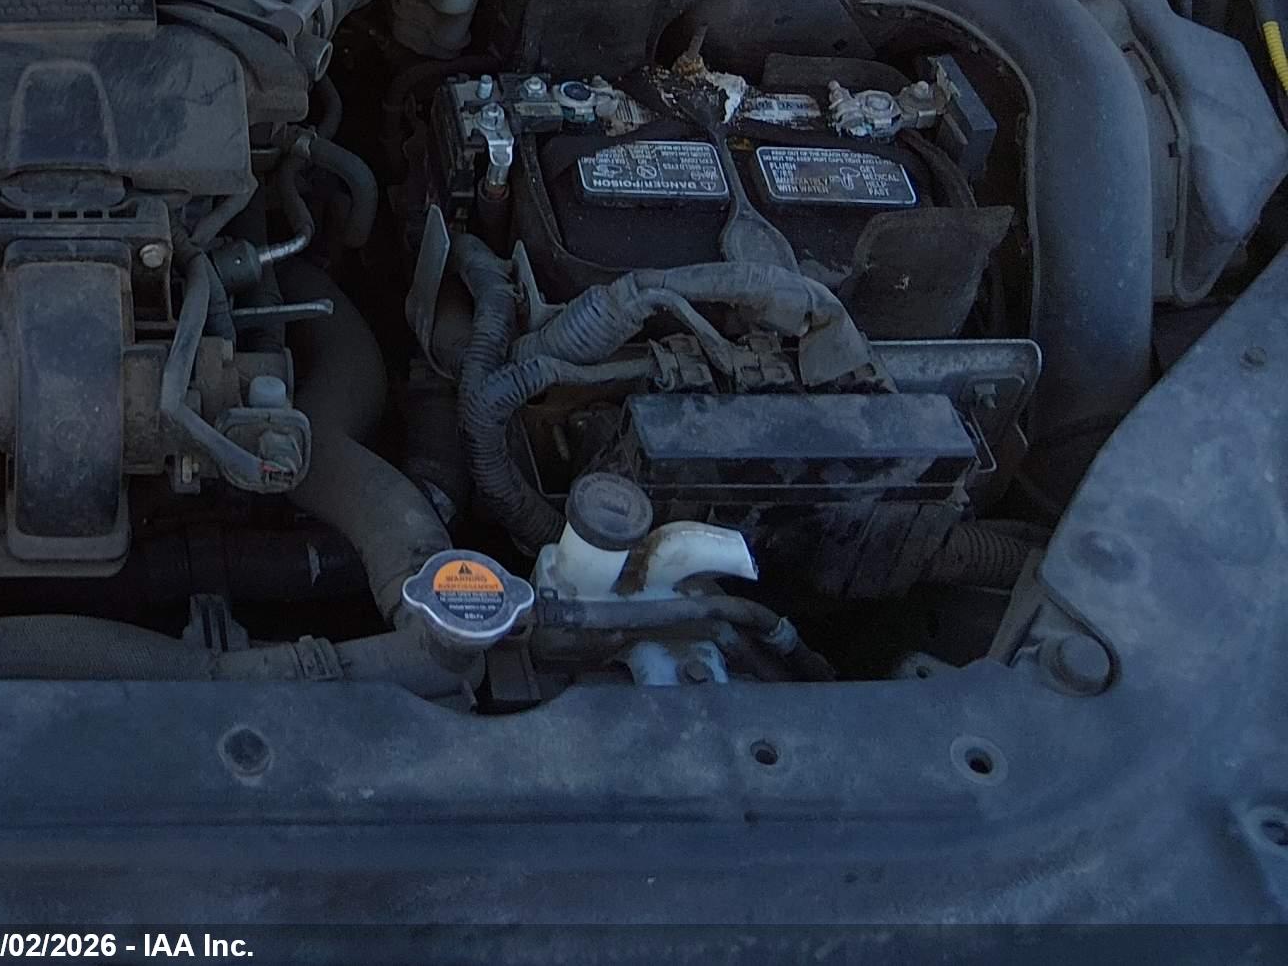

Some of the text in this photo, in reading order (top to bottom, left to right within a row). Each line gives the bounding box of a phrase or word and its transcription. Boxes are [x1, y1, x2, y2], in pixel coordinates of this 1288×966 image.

[769, 162, 797, 170] FLUSH
[862, 173, 900, 182] MEDICAL
[592, 179, 697, 190] DANGER/POISON
[777, 185, 829, 194] WITH WATER
[868, 188, 889, 196] FAST
[446, 575, 488, 583] WARNING
